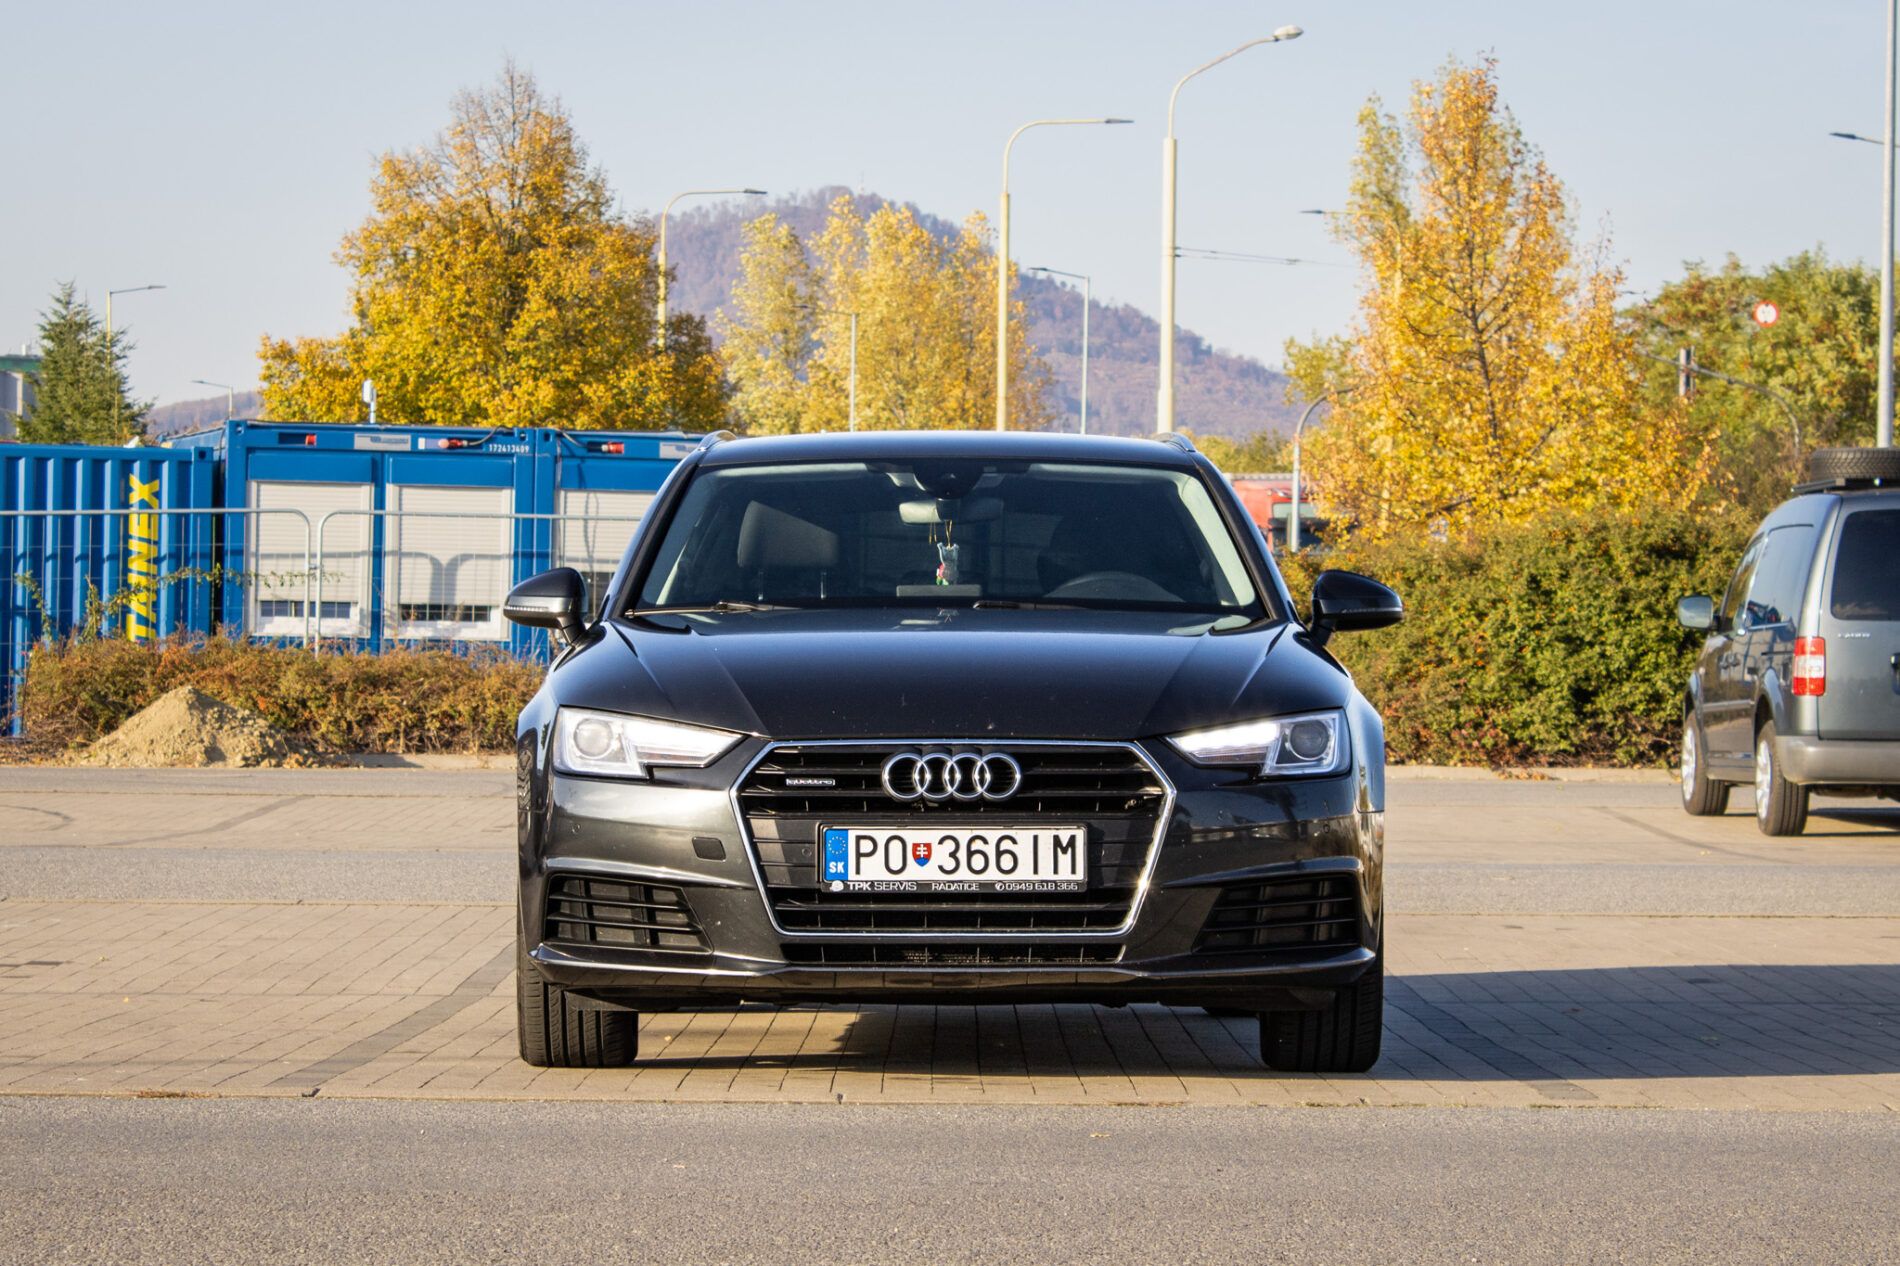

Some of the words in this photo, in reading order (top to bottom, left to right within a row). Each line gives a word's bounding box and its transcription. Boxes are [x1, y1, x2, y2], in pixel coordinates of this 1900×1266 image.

[828, 861, 845, 874] SK
[847, 881, 872, 891] TPK
[874, 881, 917, 891] SERVIS
[931, 882, 980, 891] RADATICE
[1005, 882, 1034, 891] 0949
[1034, 882, 1056, 891] 618
[1056, 882, 1078, 891] 366
